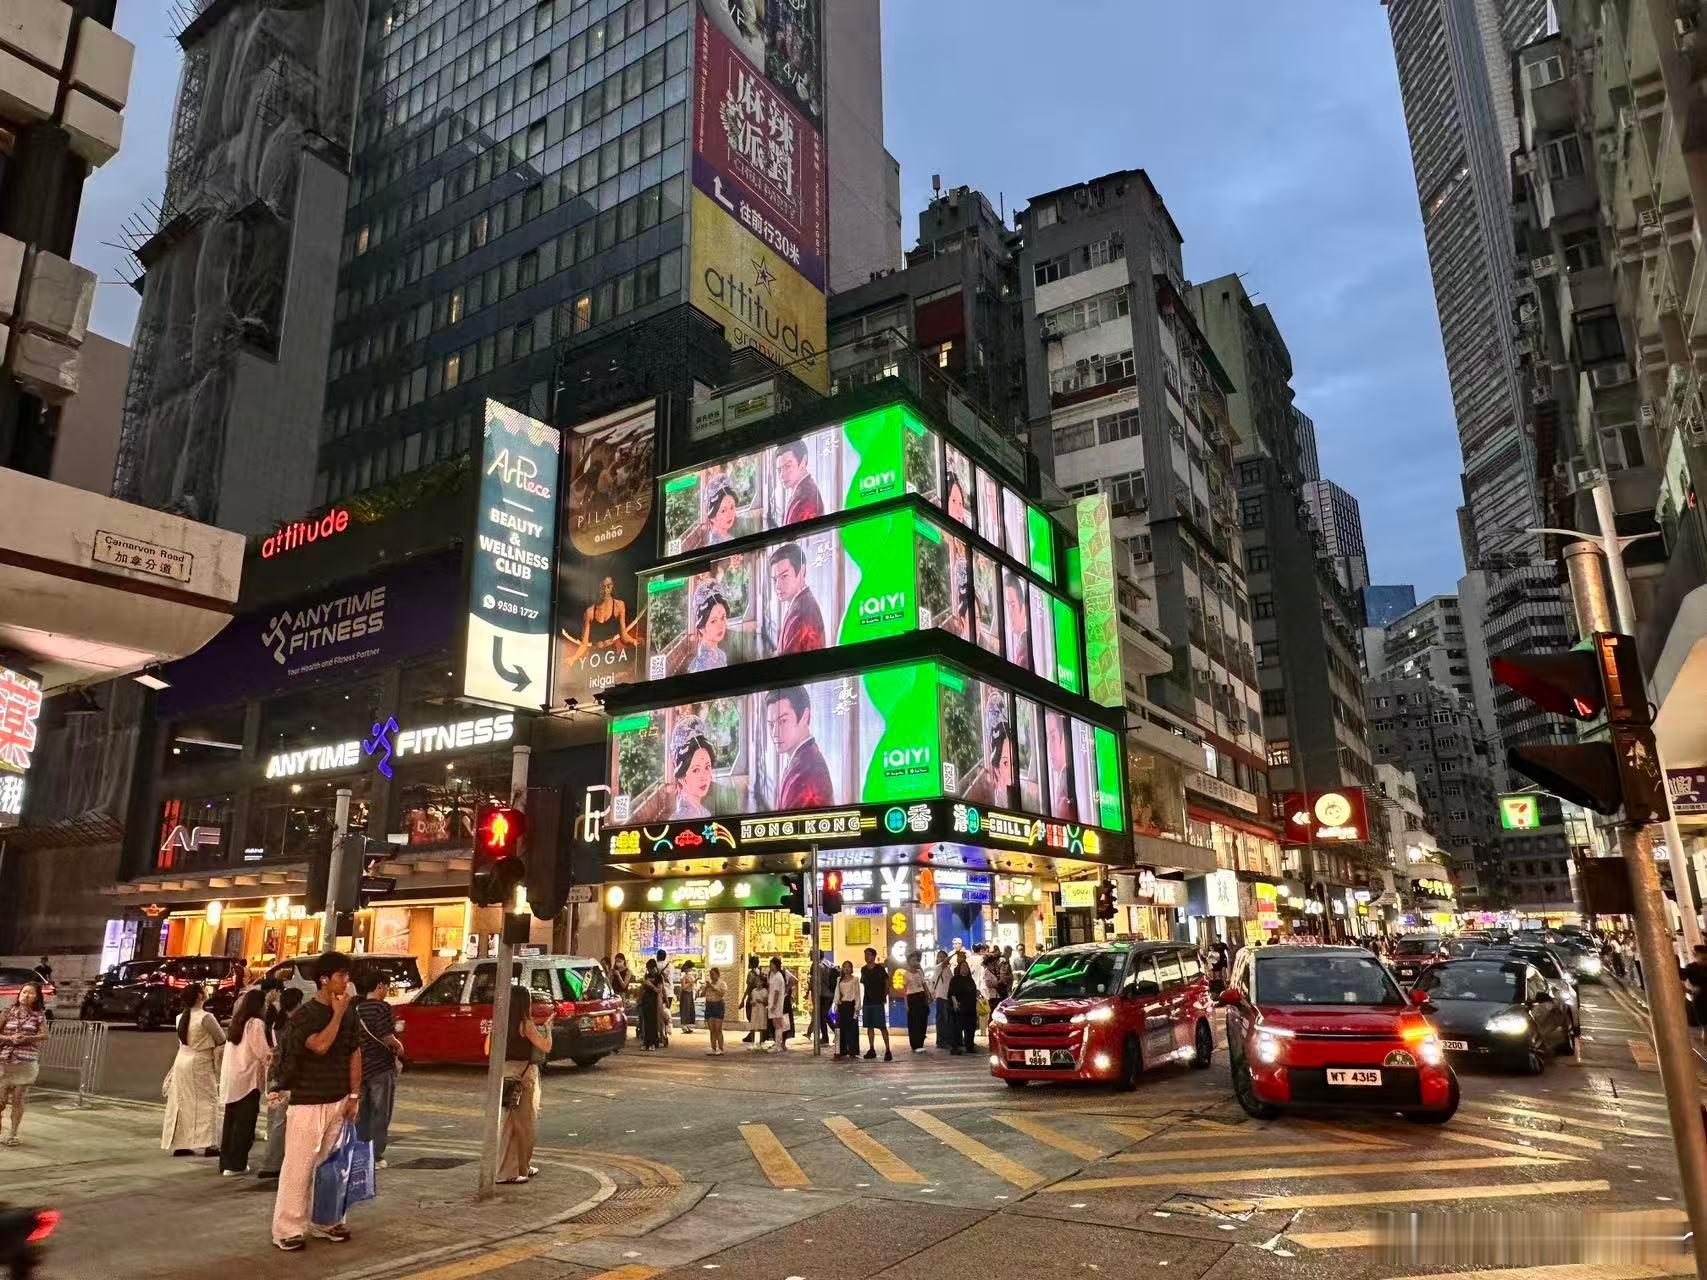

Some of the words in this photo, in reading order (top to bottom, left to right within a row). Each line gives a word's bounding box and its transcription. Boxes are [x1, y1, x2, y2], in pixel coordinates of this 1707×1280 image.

[736, 69, 794, 156] 麻辣
[739, 200, 801, 265] 往前行30米
[704, 267, 816, 368] attitude
[491, 507, 544, 539] BEAUTY
[577, 497, 643, 529] PILATES
[262, 509, 349, 559] attitude
[509, 532, 521, 547] &
[105, 536, 156, 556] Carnarvon
[160, 549, 185, 568] Road
[114, 551, 173, 575] 加拿分道
[479, 534, 550, 571] WELLNESS
[495, 559, 532, 580] CLUB
[292, 586, 387, 632] ANYTIME
[497, 600, 518, 615] 9538
[520, 606, 539, 620] 1727
[859, 592, 905, 617] iQIYI
[289, 610, 384, 655] FITNESS
[300, 662, 322, 674] Health
[322, 658, 334, 668] and
[334, 653, 356, 666] Fitness
[356, 647, 380, 660] Partner
[580, 648, 628, 671] YOGA
[266, 740, 360, 779] ANYTIME
[396, 713, 515, 757] FITNESS
[883, 746, 930, 768] iQIYI
[741, 821, 794, 839] HONG
[805, 817, 860, 834] KONG
[908, 803, 932, 832] 香
[161, 825, 221, 851] AF
[1330, 1071, 1346, 1082] WT
[1351, 1071, 1378, 1083] 4315
